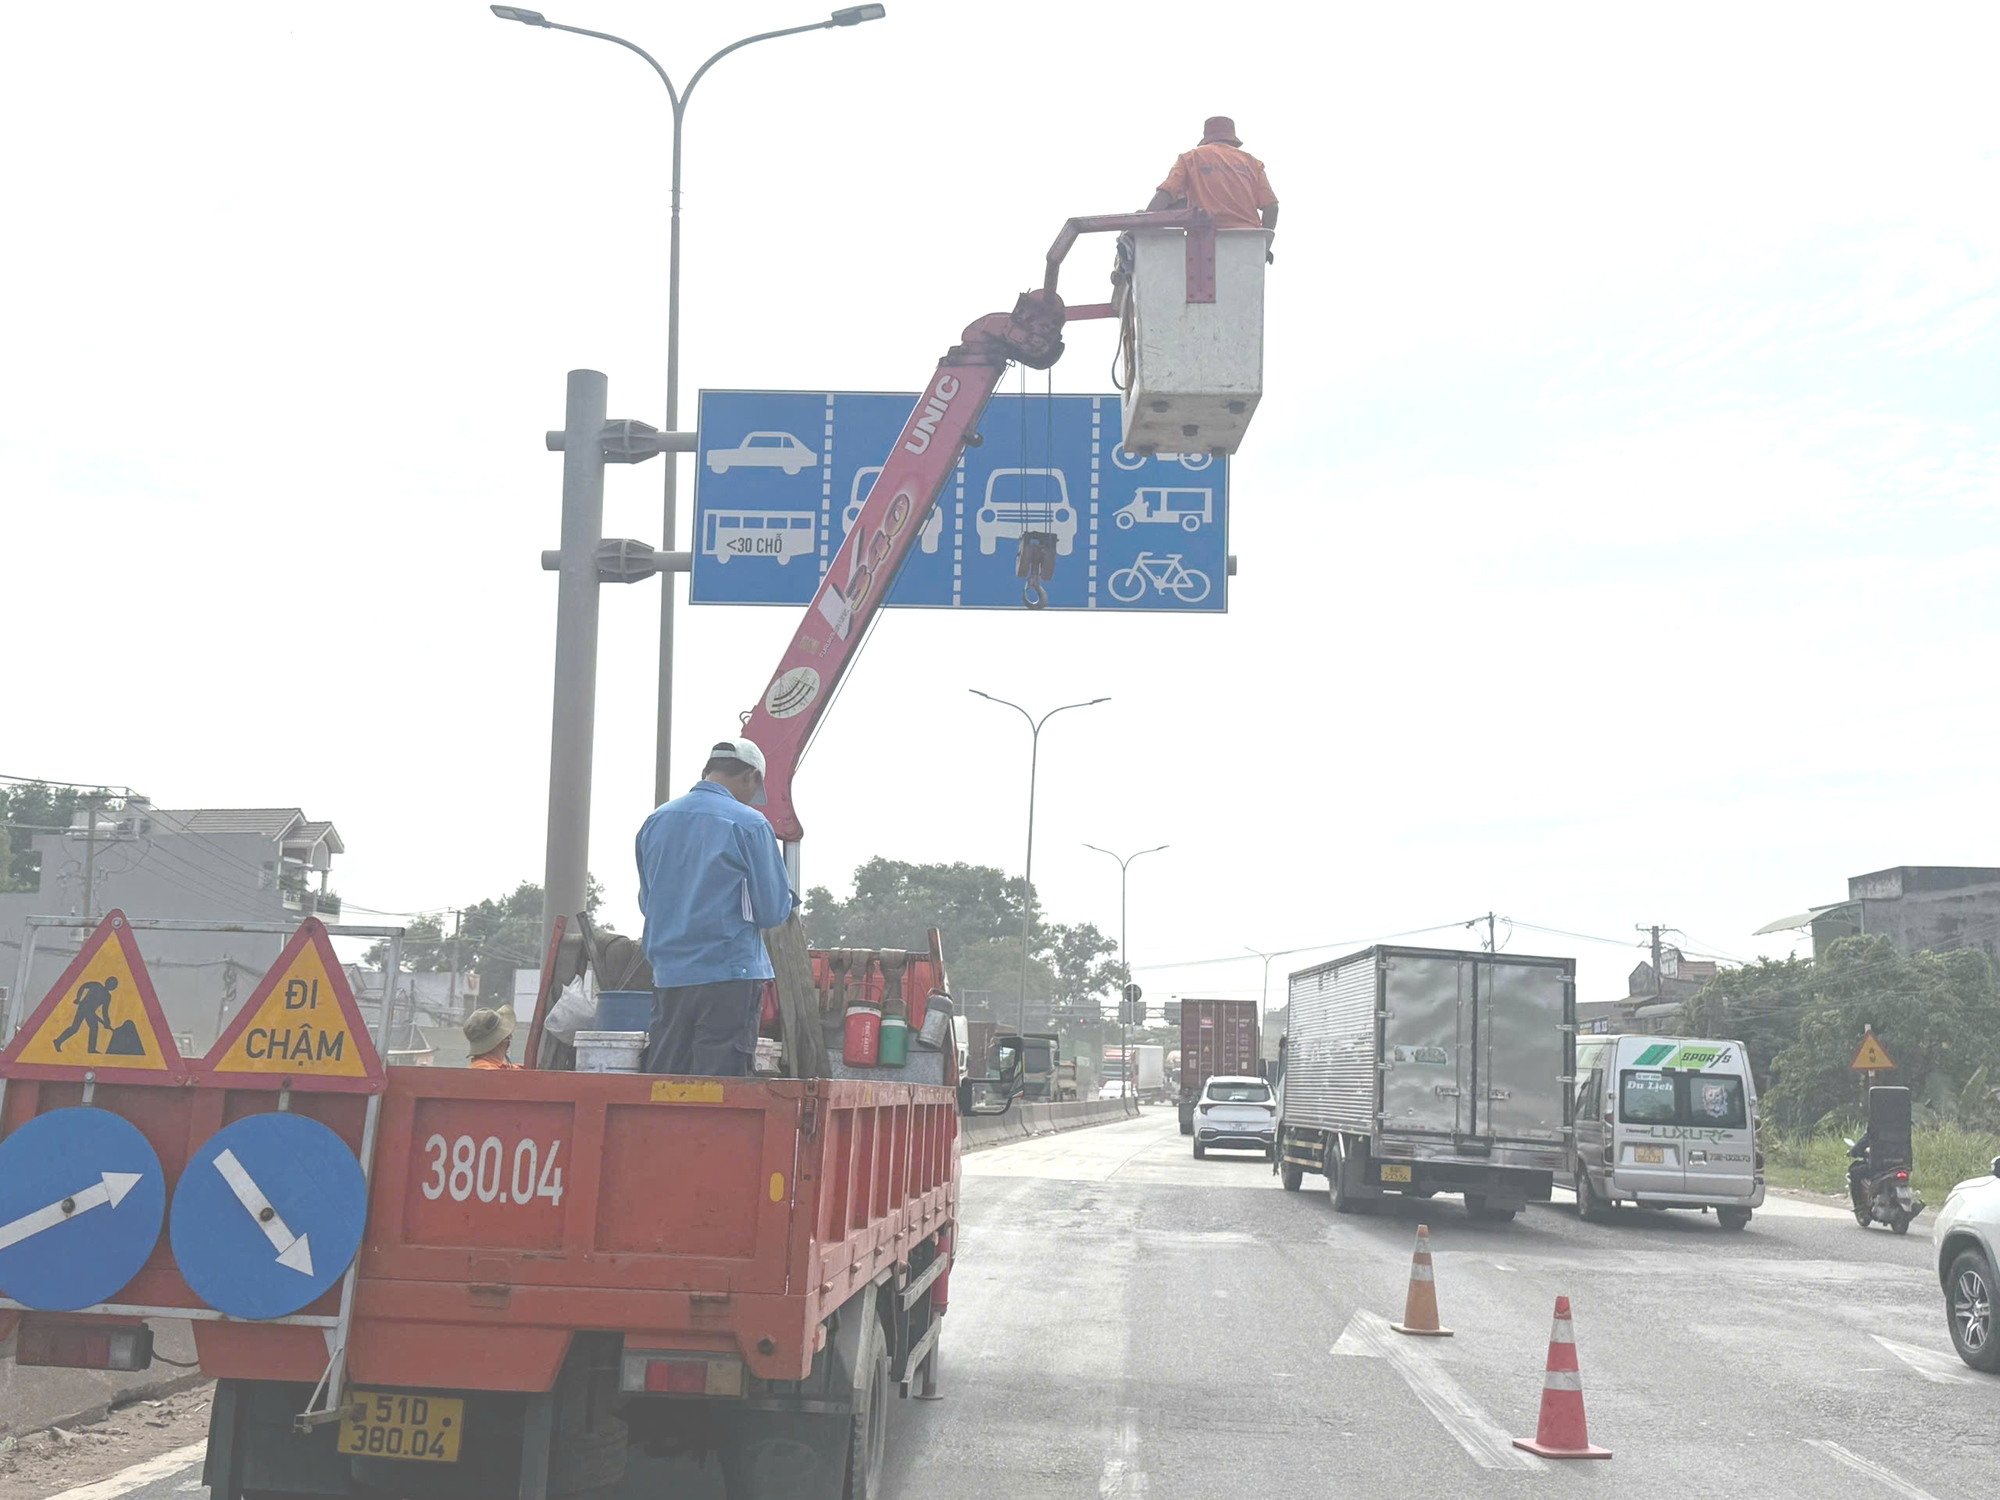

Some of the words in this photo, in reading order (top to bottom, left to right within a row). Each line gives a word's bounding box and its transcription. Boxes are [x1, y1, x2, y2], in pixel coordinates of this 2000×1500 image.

[905, 375, 960, 455] UNIC
[726, 537, 752, 553] <30
[756, 533, 783, 554] CHỖ
[845, 493, 910, 612] 340
[285, 979, 318, 1009] ĐI
[246, 1023, 345, 1066] CHẬM
[1681, 1048, 1732, 1068] SPORTS
[1627, 1081, 1644, 1090] Du
[1650, 1126, 1725, 1145] LUXURY
[422, 1134, 563, 1206] 380.04
[376, 1396, 428, 1425] 51D
[350, 1425, 445, 1458] 380.04
